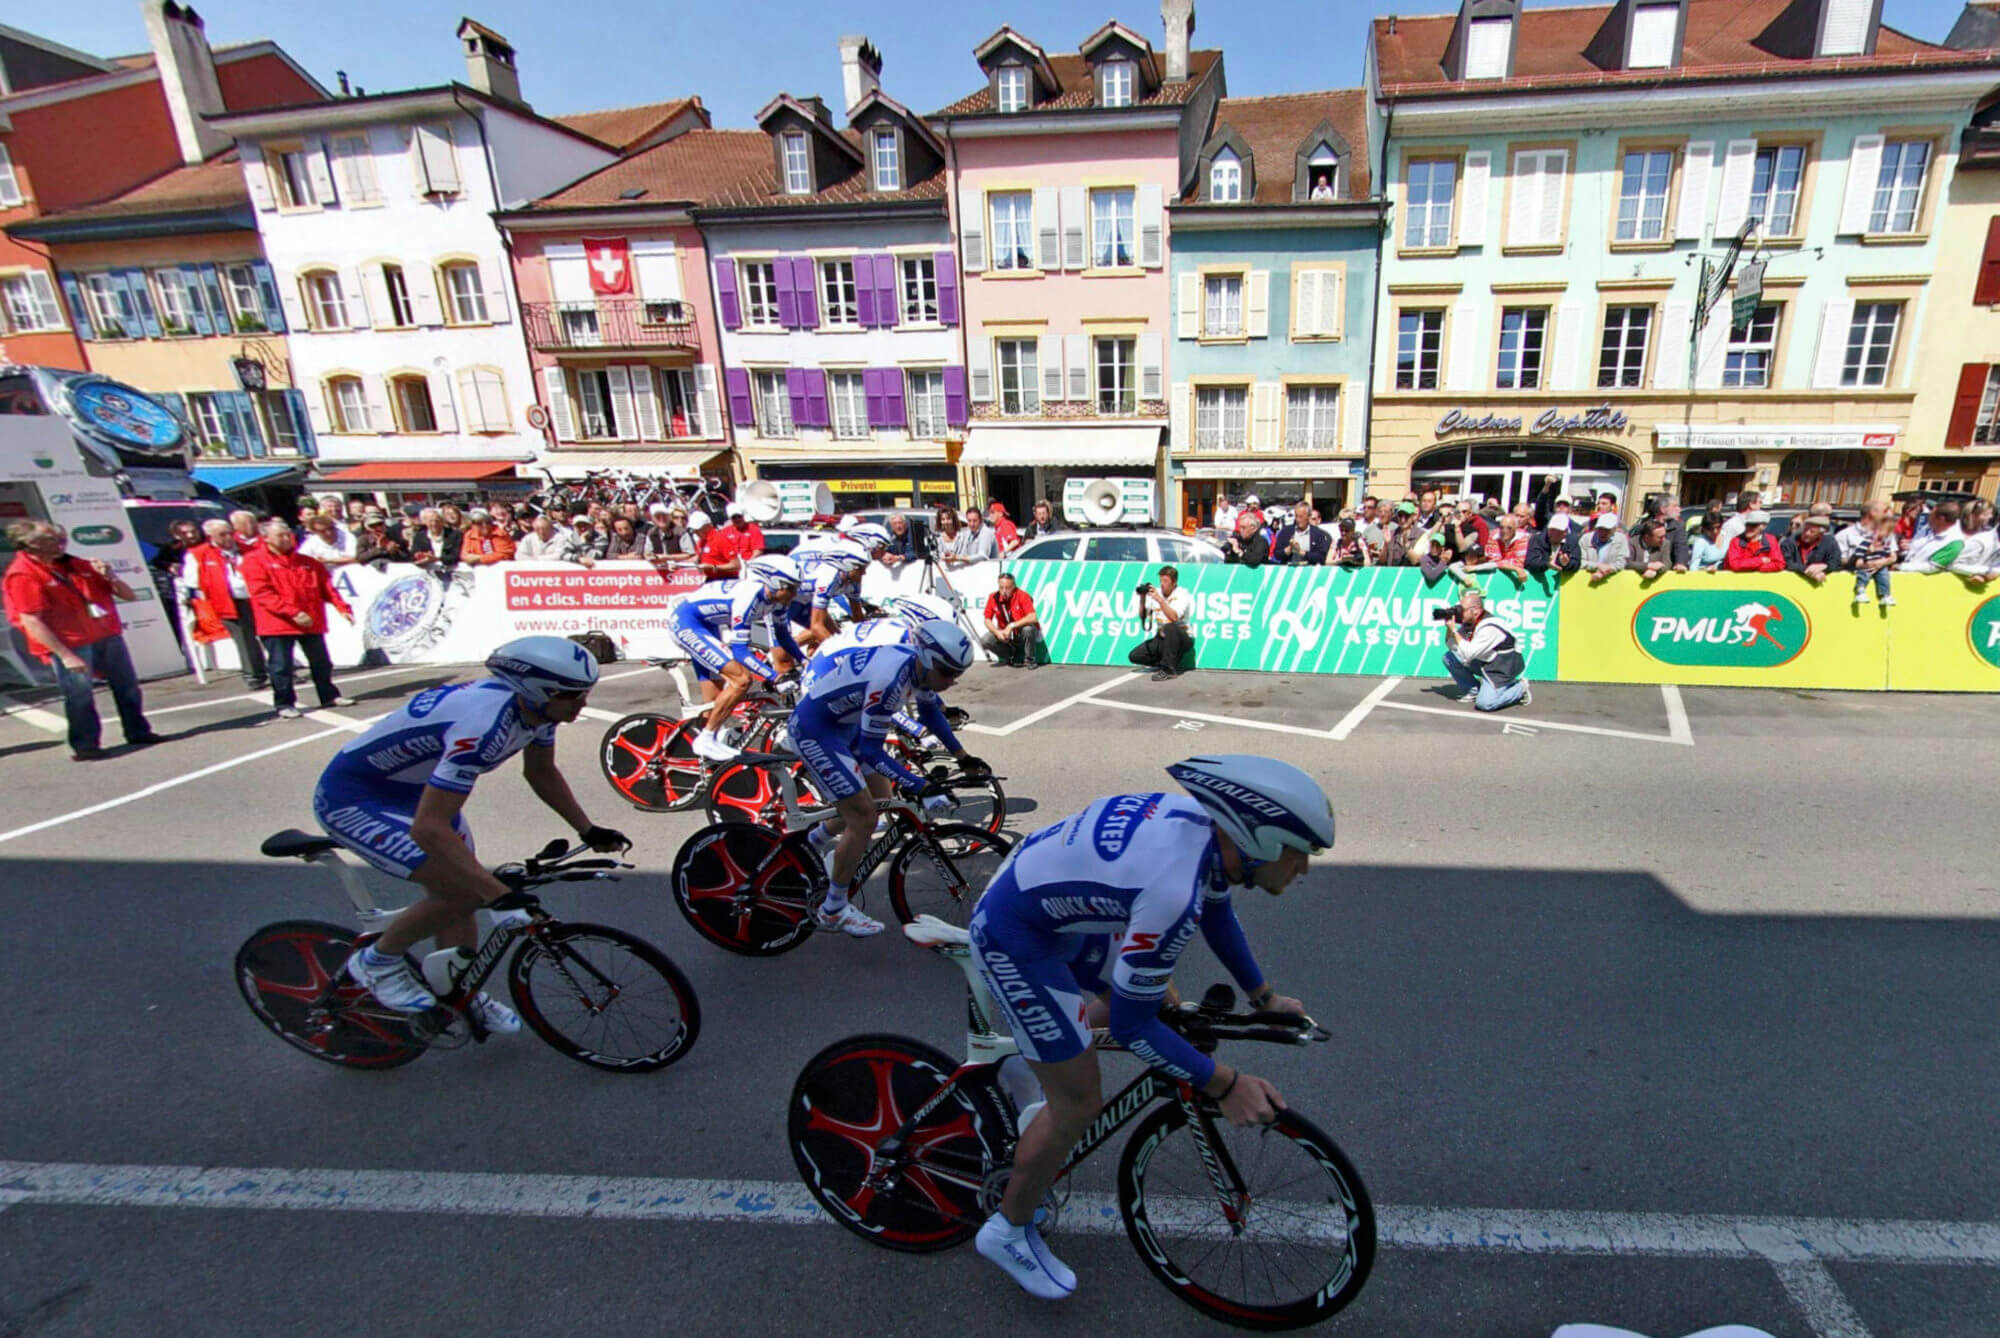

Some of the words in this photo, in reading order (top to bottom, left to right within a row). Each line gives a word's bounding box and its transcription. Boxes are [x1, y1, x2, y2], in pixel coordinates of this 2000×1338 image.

[1530, 401, 1629, 434] Capitole
[509, 574, 562, 587] Ouvrez
[570, 575, 585, 587] un
[587, 573, 642, 589] compte
[645, 574, 663, 586] en
[666, 572, 707, 586] Suiss
[511, 595, 530, 607] en
[532, 594, 543, 606] 4
[545, 593, 581, 607] clics.
[583, 592, 671, 606] Rendez-vou
[1063, 590, 1253, 622] VAUISE
[1334, 596, 1547, 631] VAUDSE
[514, 616, 672, 632] www.ca-financeme
[1071, 620, 1252, 640] ASSUCES
[1343, 628, 1546, 650] ASSURES
[1650, 616, 1733, 644] PMU
[677, 628, 707, 652] QUICK
[703, 649, 725, 667] STEP
[367, 744, 416, 771] QUICK
[404, 735, 443, 757] STEP
[799, 738, 835, 773] QUICK
[823, 771, 856, 796] STEP
[1180, 769, 1289, 818] SPECIALIZED
[325, 806, 393, 845] QUICK
[375, 831, 426, 863] STEP
[1099, 814, 1132, 853] STEP
[1040, 895, 1091, 920] QUICK
[1159, 915, 1200, 962] QUICK
[983, 951, 1039, 1004] QUICK
[1014, 1004, 1064, 1043] STEP
